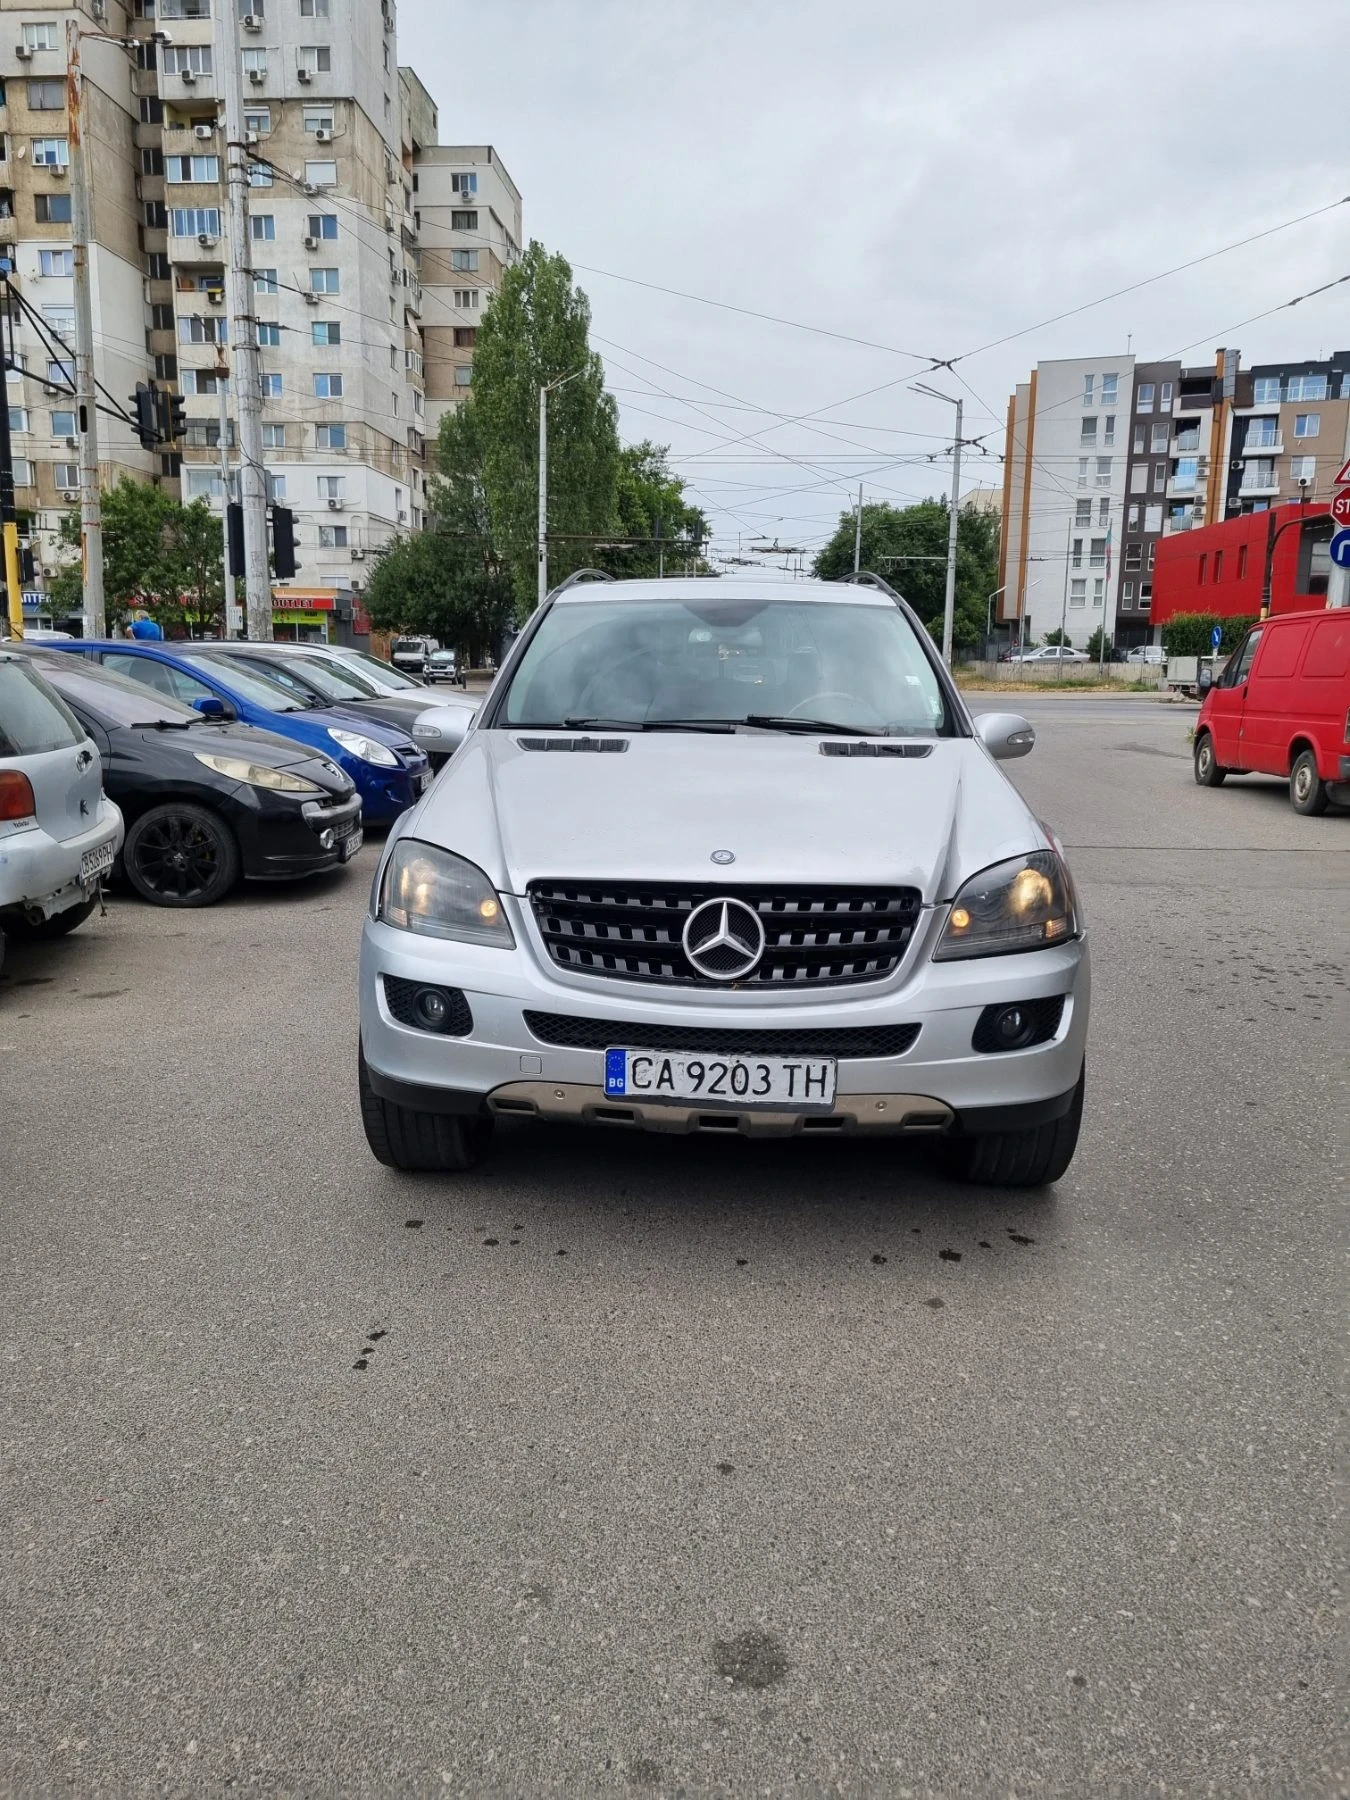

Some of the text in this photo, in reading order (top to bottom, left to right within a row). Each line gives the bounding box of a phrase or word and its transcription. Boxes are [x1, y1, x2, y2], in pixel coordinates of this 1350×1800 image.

[272, 599, 312, 609] OUTLET
[631, 1057, 828, 1098] CA 9203 TH
[608, 1078, 624, 1088] BG
